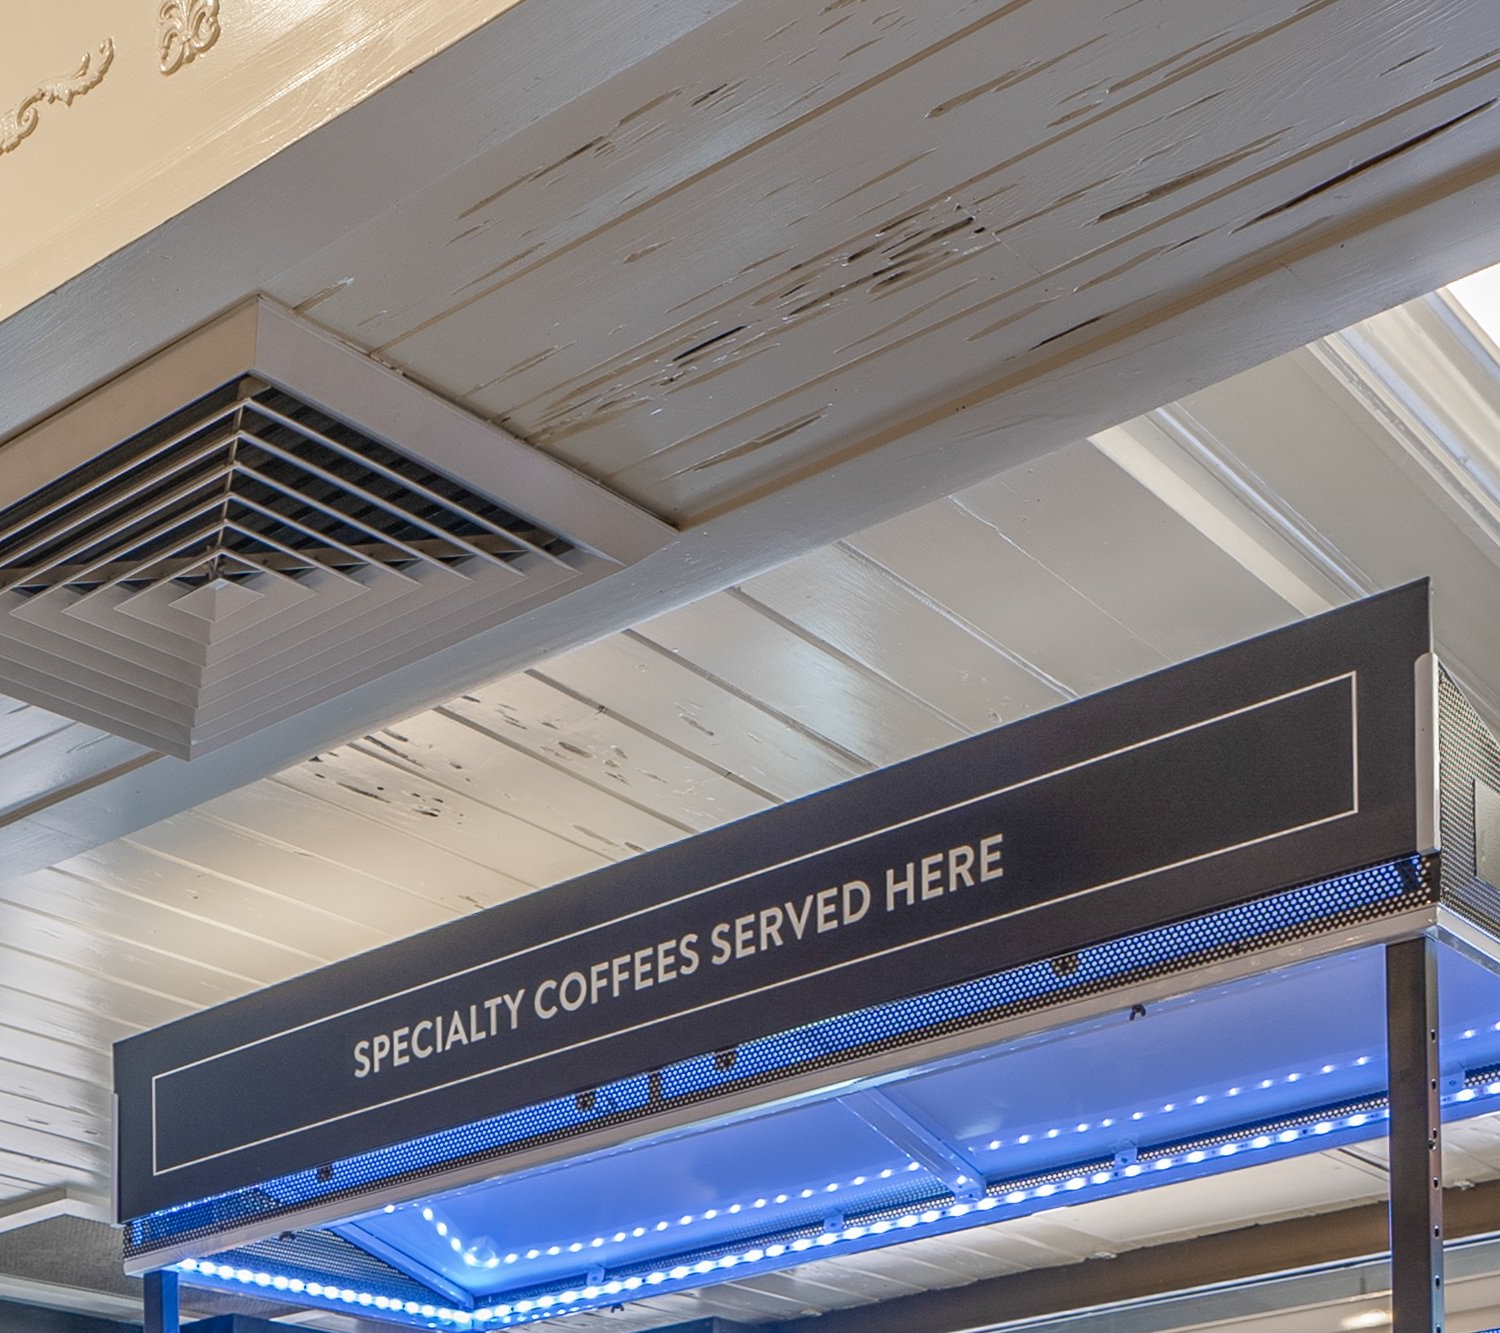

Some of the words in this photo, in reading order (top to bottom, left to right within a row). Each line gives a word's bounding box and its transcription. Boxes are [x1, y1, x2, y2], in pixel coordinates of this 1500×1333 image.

[353, 988, 526, 1078] SPECIALTY
[534, 932, 699, 1020] COFFEES
[710, 880, 871, 966] SERVED
[885, 834, 1004, 911] HERE
